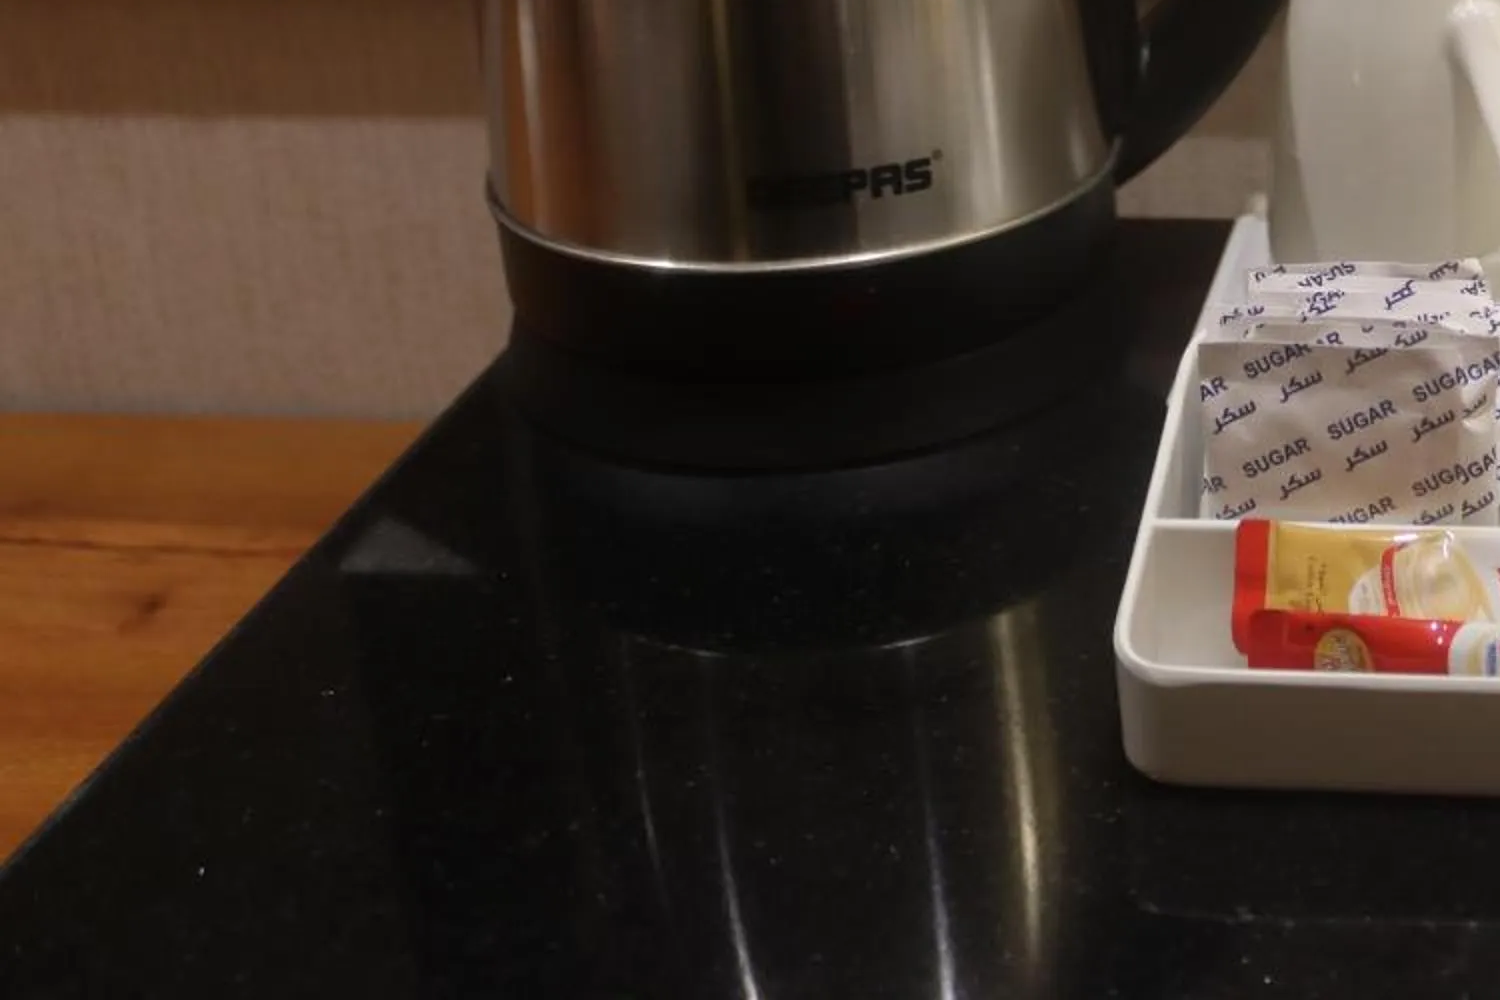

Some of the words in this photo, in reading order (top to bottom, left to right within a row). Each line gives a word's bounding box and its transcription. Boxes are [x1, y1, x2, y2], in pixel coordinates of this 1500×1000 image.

[1280, 371, 1324, 403] سكر
[1212, 400, 1257, 435] سكر
[1327, 399, 1398, 441] SUGAR
[1411, 410, 1455, 444] سكر
[1242, 438, 1312, 479] SUGAR
[1344, 439, 1389, 472] سكر
[1279, 468, 1323, 501] سكر
[1328, 496, 1397, 523] UGAR
